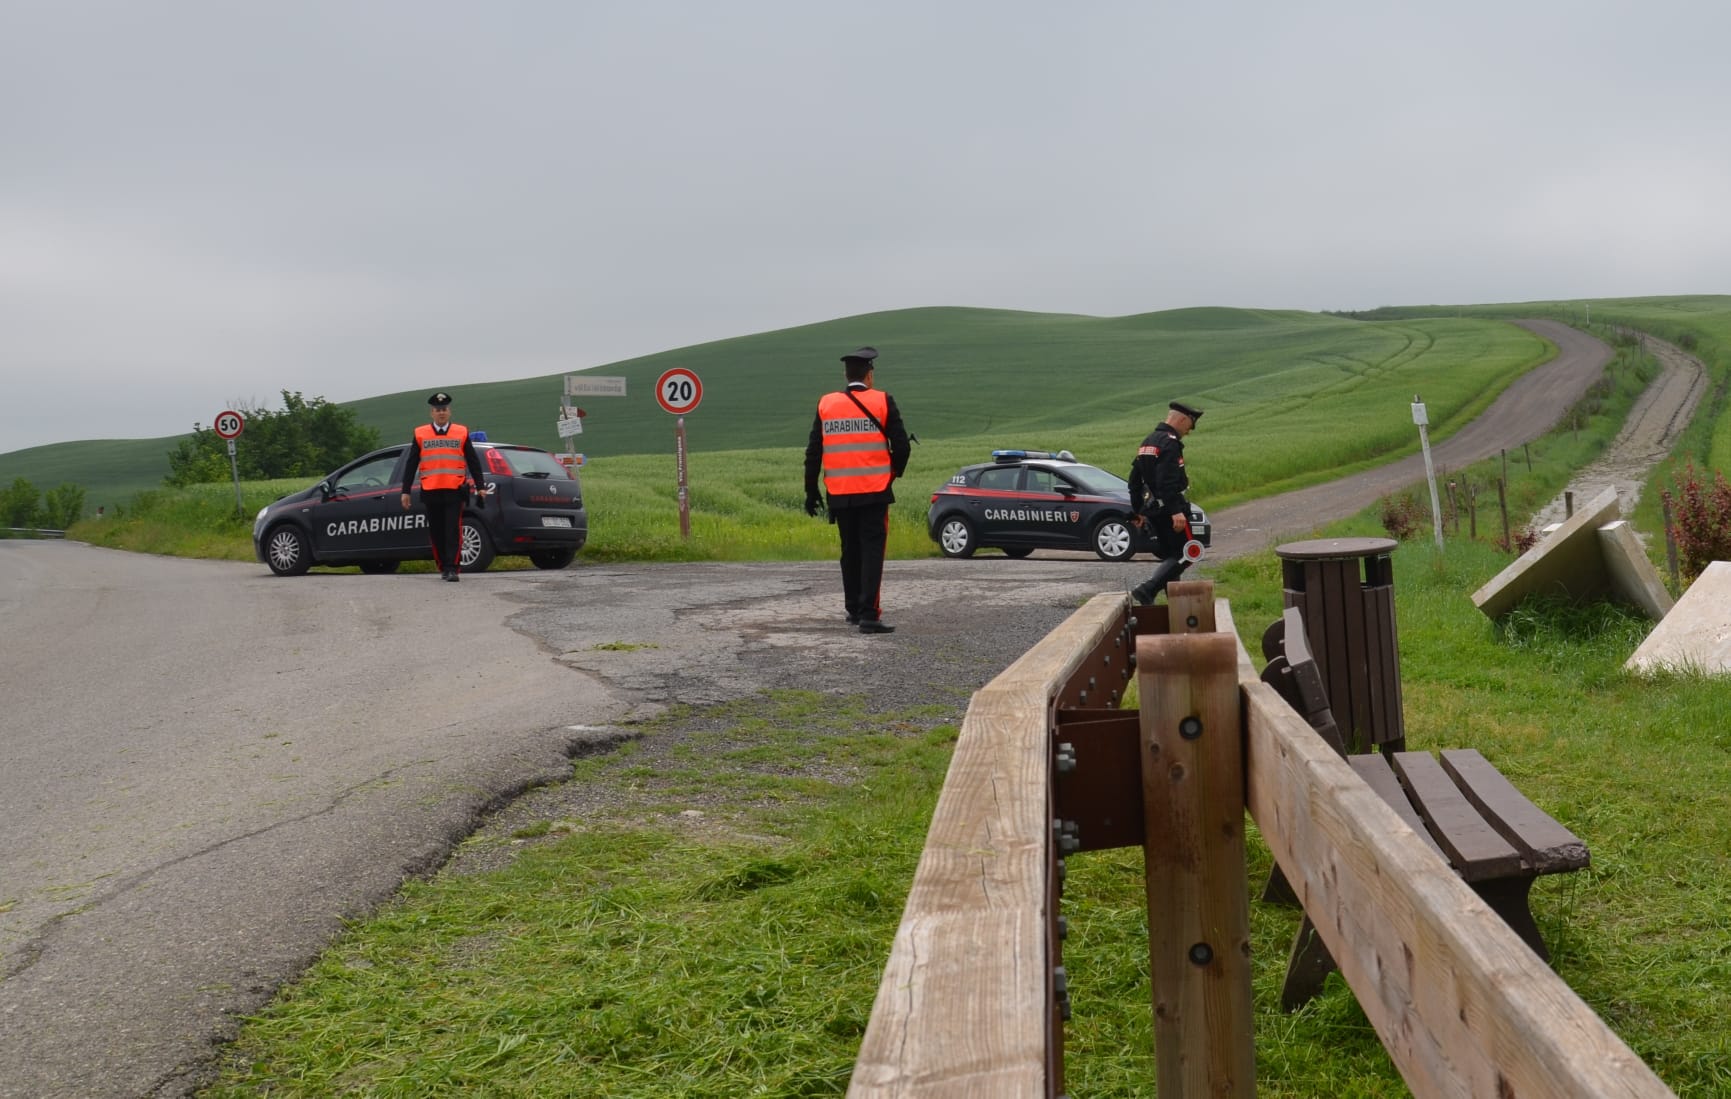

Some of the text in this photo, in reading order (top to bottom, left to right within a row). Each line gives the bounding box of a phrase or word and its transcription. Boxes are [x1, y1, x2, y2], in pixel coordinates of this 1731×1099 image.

[667, 381, 692, 401] 20
[221, 418, 238, 431] 50
[952, 475, 966, 484] 112
[984, 508, 1068, 522] CARABINIERI
